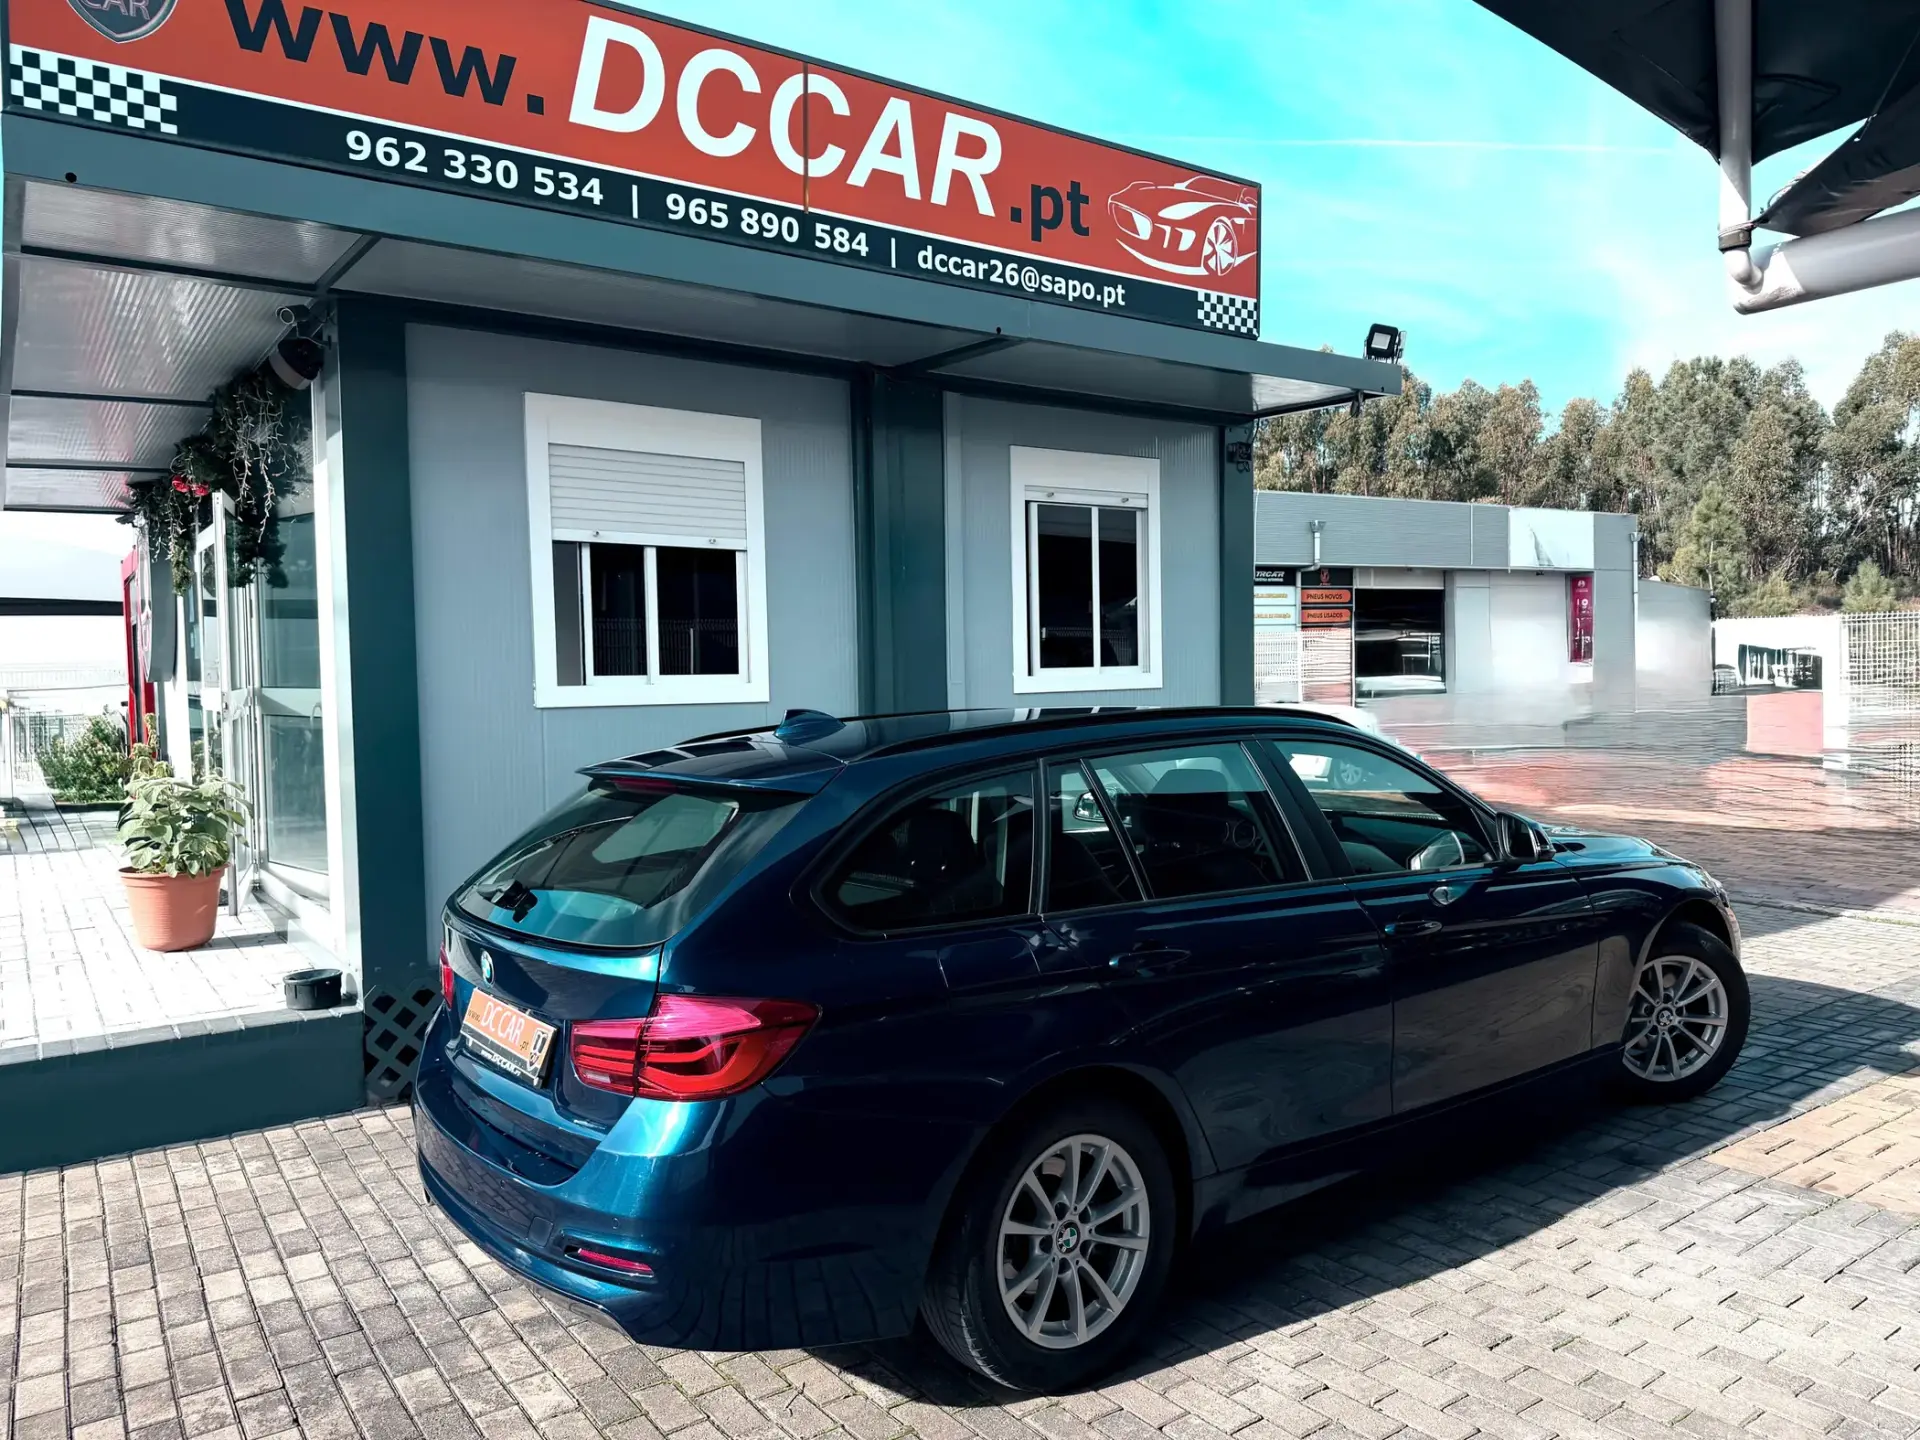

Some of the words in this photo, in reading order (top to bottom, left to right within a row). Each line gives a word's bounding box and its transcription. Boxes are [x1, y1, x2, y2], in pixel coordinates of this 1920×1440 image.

[79, 0, 151, 20] AR
[346, 130, 428, 173] 962
[444, 149, 518, 189] 330
[534, 166, 604, 205] 534
[666, 193, 729, 229] 965
[740, 207, 799, 243] 890
[815, 222, 869, 257] 584
[917, 245, 1126, 308] dccar26@sapo.pt
